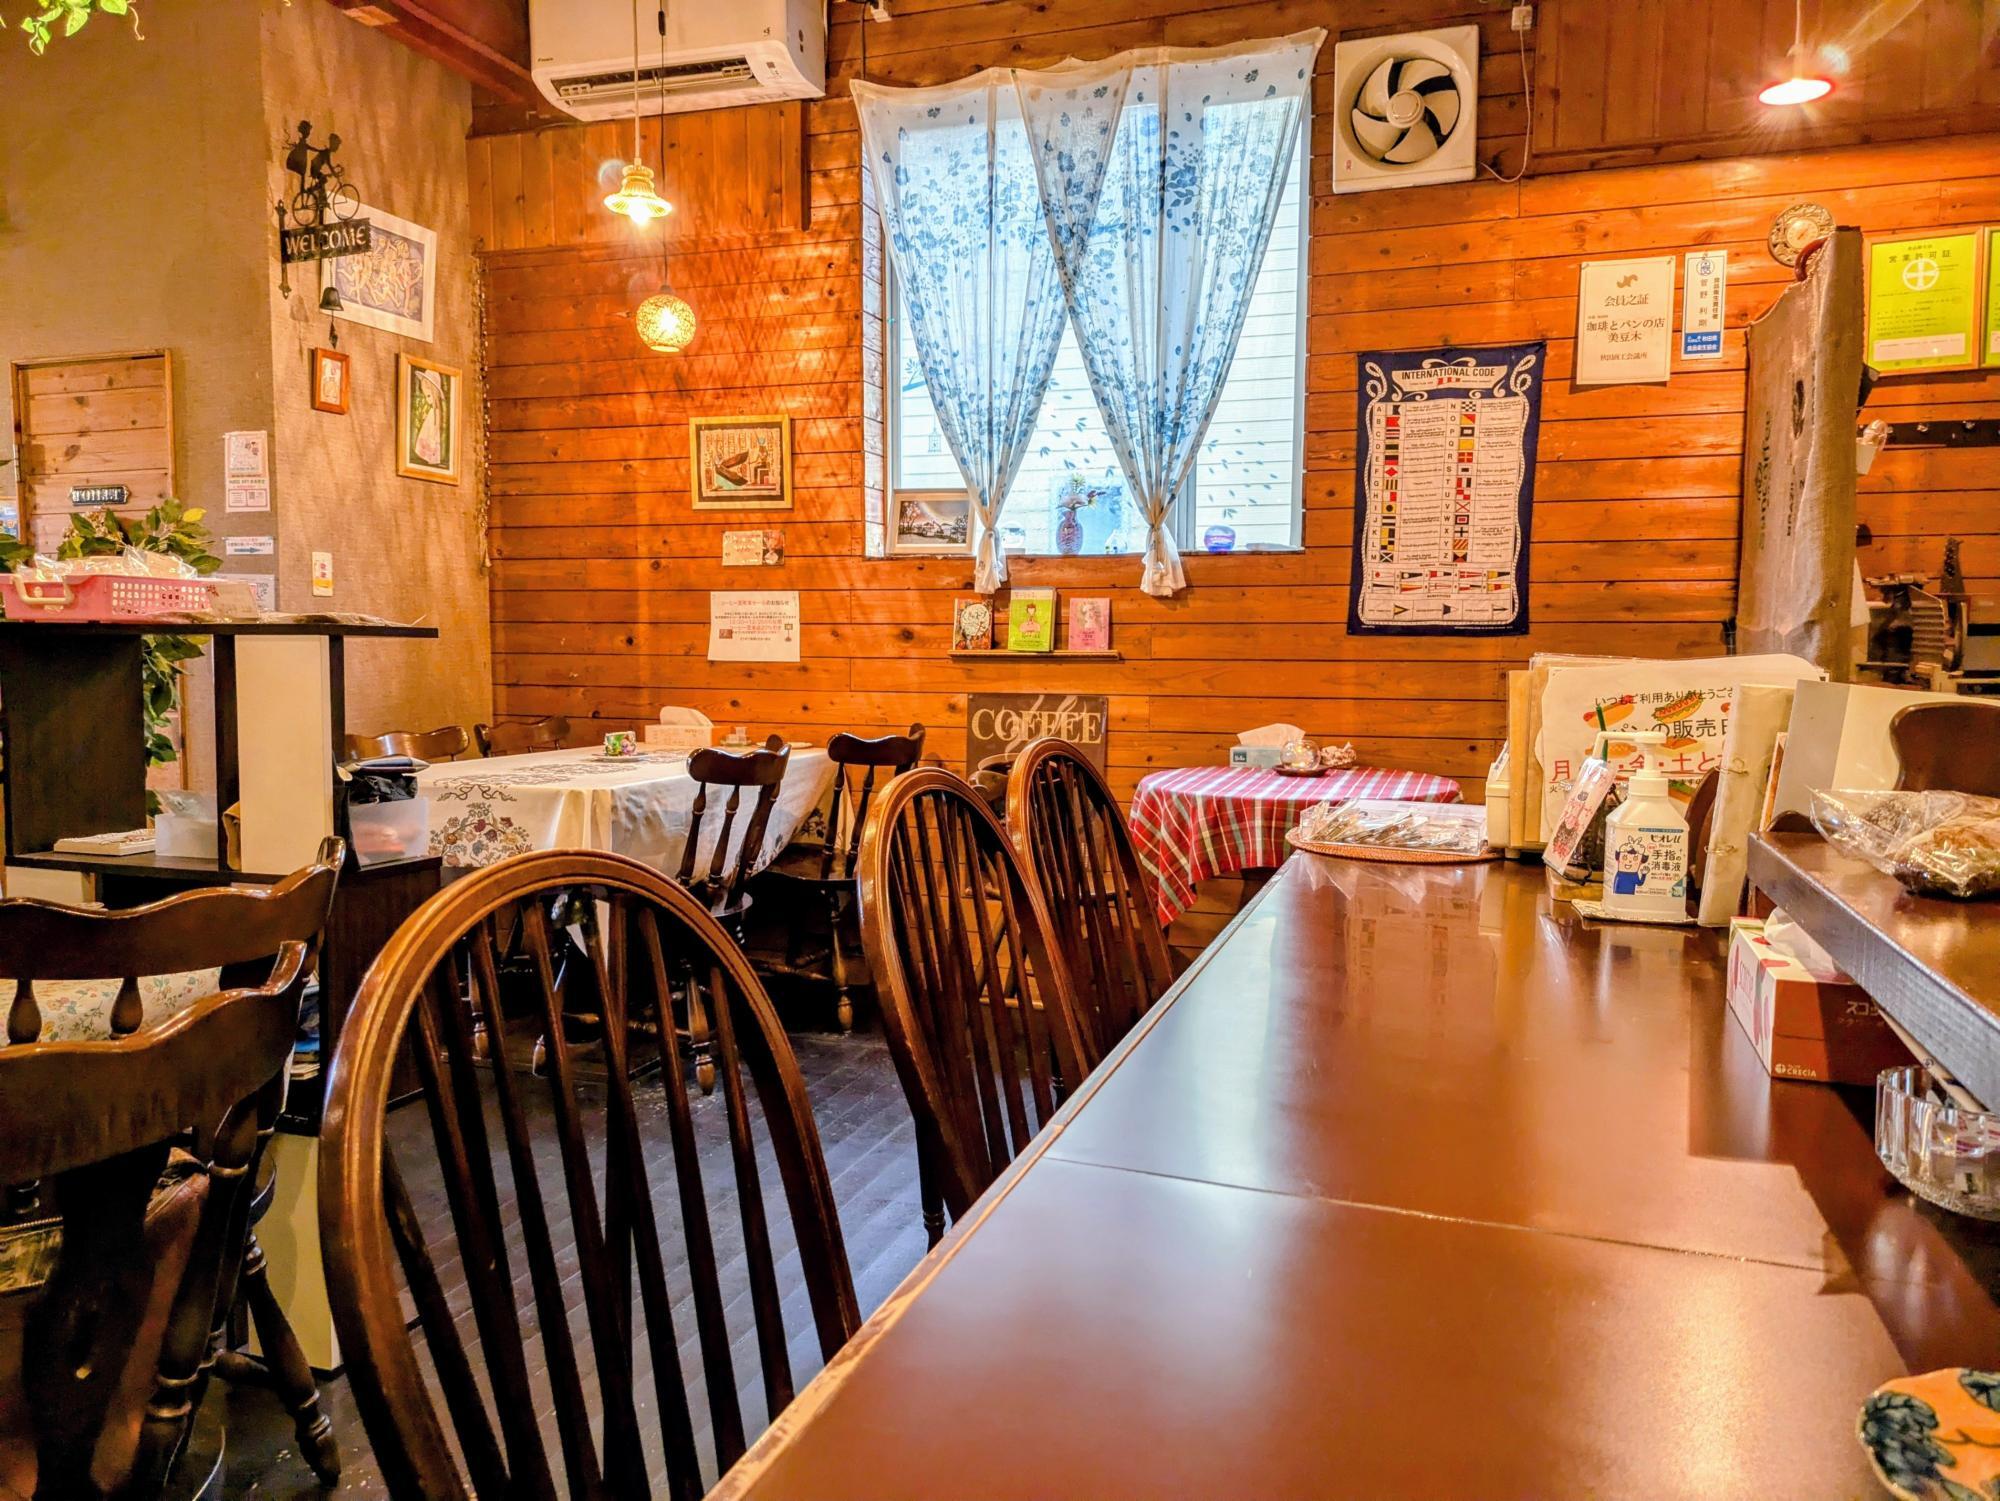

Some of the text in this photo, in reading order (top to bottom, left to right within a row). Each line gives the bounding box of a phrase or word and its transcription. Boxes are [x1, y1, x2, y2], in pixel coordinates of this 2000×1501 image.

[285, 226, 366, 255] WELCOME
[1586, 317, 1666, 331] 珈琲とパンの店
[1608, 330, 1642, 343] 美豆木
[1401, 366, 1496, 380] INTERNATIONAL CODE
[971, 707, 1102, 744] COFFEE
[1651, 849, 1682, 861] 手指の
[1651, 861, 1681, 872] 消毒液
[1786, 1068, 1817, 1078] CRECIA
